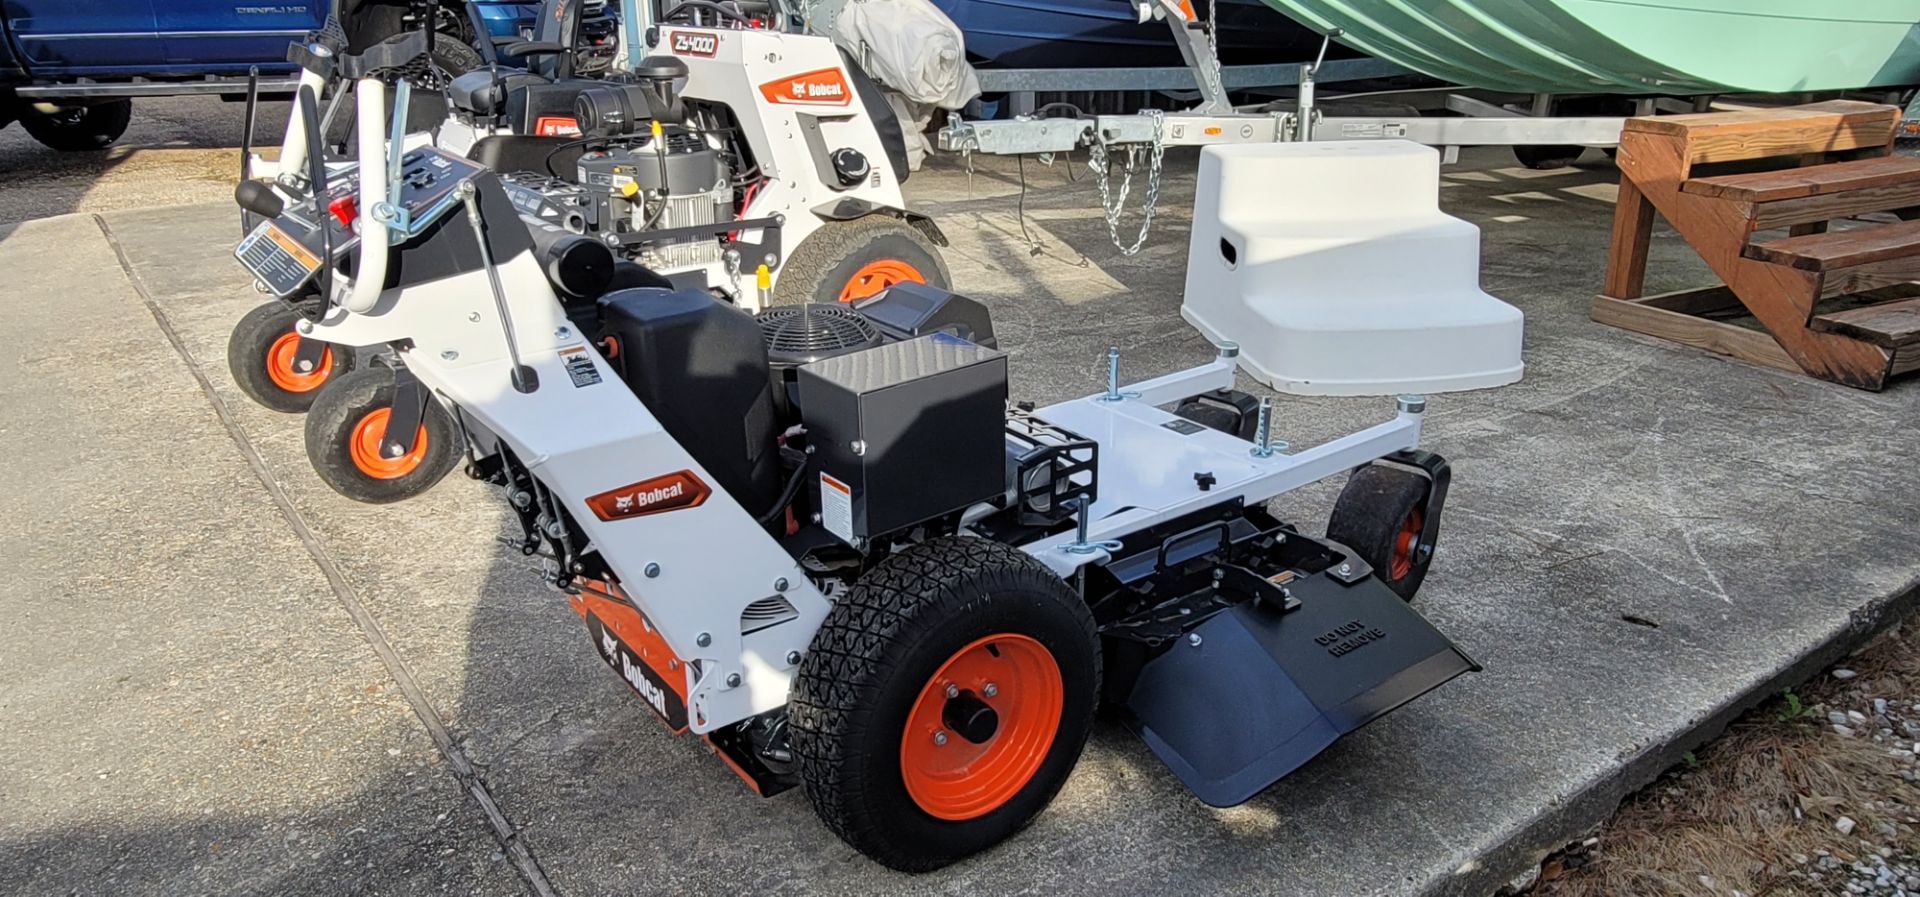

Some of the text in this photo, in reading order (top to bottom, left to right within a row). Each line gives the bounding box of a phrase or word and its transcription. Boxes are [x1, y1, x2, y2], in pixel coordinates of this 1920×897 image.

[235, 6, 285, 14] DENALI
[675, 34, 715, 53] ZS4000
[808, 82, 843, 97] Bobcat
[557, 125, 581, 135] Bobca
[637, 482, 683, 507] Bobcat
[1314, 620, 1365, 646] DO NOT
[1328, 628, 1386, 658] REMOVE
[621, 650, 669, 720] Bobcat
